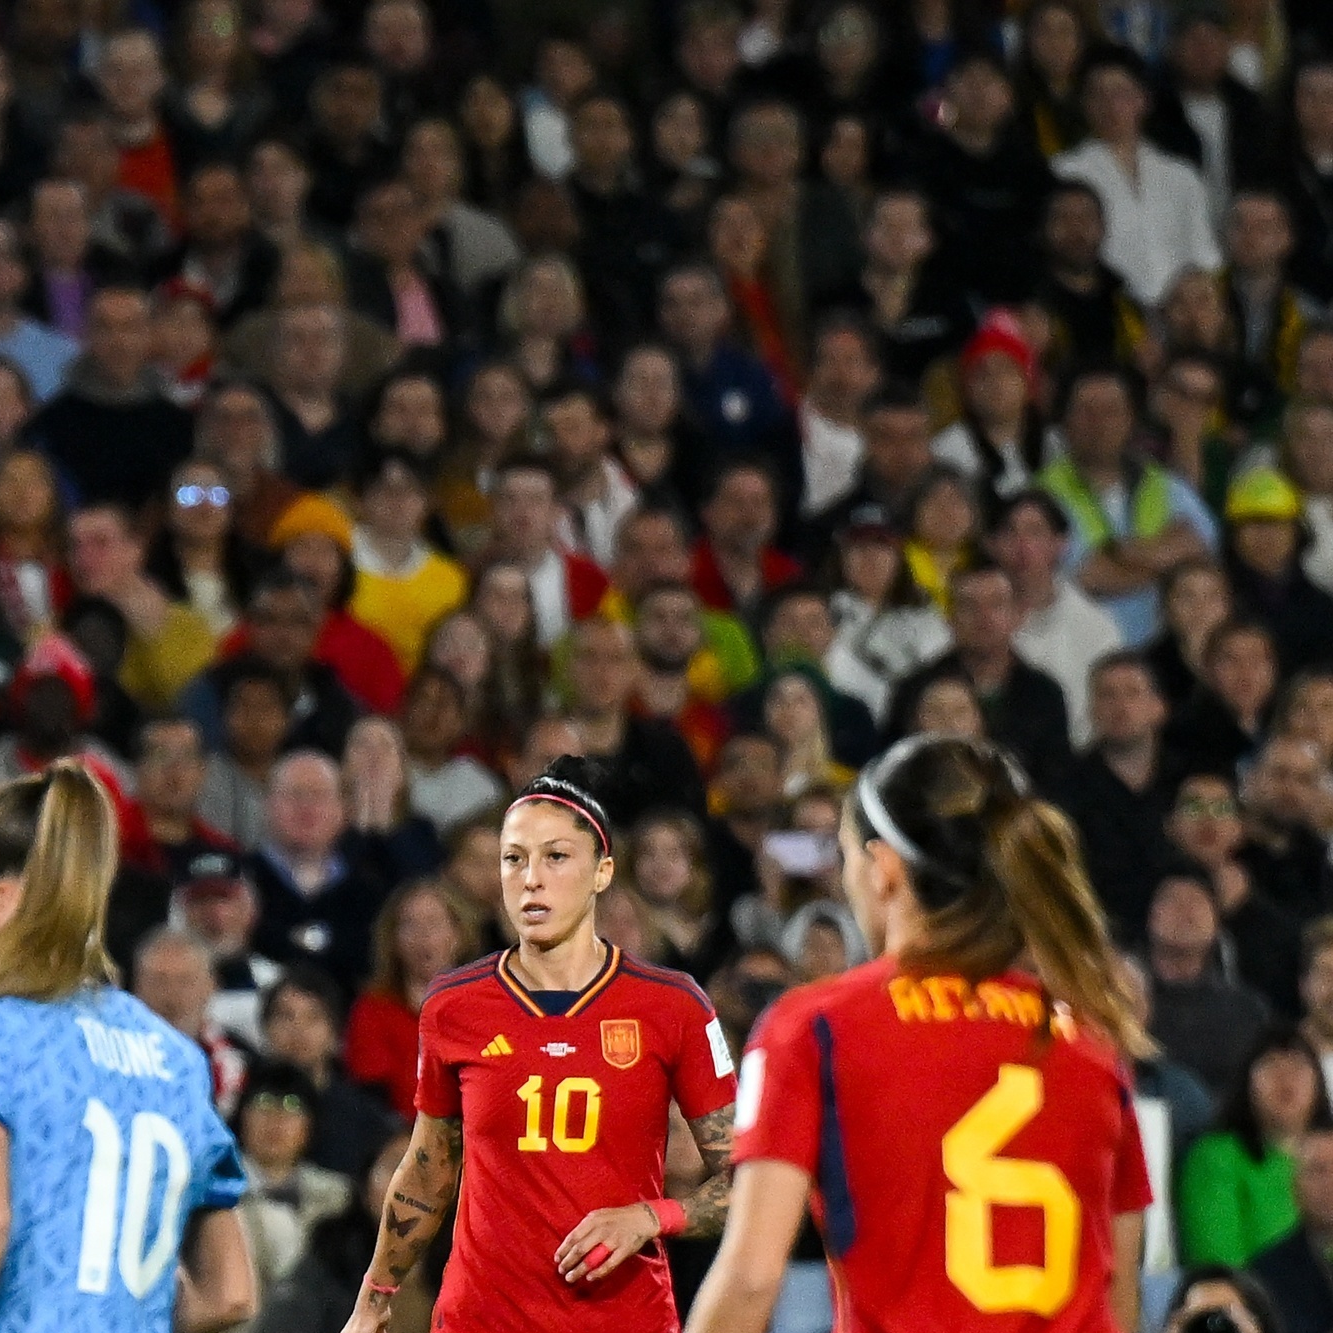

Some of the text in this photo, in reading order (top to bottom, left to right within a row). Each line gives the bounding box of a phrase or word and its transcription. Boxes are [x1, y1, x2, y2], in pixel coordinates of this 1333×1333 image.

[77, 1097, 192, 1299] 10
[516, 1074, 602, 1153] 10
[941, 1063, 1082, 1320] 6
